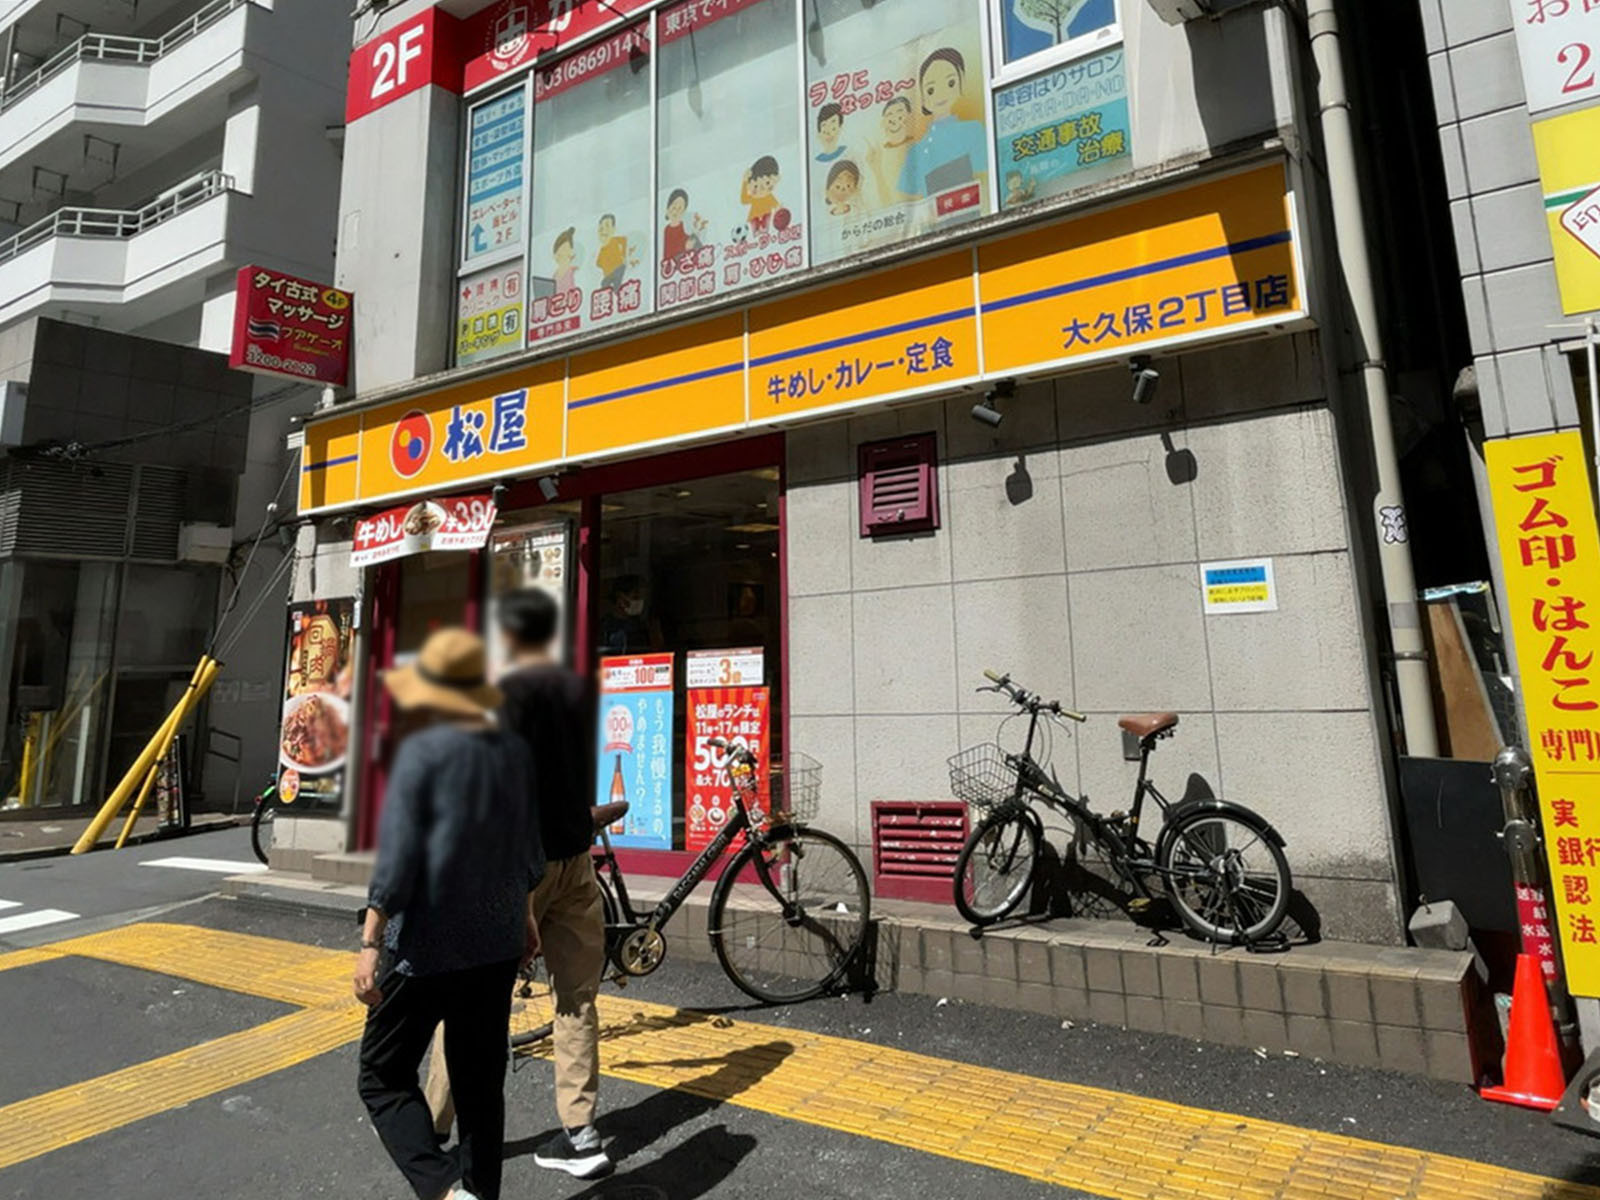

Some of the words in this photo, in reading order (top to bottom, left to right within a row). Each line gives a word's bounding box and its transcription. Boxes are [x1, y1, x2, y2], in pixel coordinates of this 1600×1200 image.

[1527, 0, 1600, 24] お
[370, 24, 424, 99] 2F
[808, 70, 869, 107] ラクに
[998, 52, 1124, 112] 美容はりサロン
[1012, 112, 1102, 162] 交通事故
[1077, 130, 1125, 166] 治療
[255, 272, 318, 303] タイ古式
[590, 279, 641, 320] 腰痛
[267, 297, 344, 329] マッサージ
[1062, 275, 1290, 349] 大久保2丁目店
[767, 336, 953, 403] 牛めし・カレー・定食
[441, 388, 528, 462] 松屋
[357, 513, 402, 547] 牛めし
[1512, 454, 1600, 712] ゴム印・はんこ
[1541, 728, 1600, 762] 専門
[1551, 799, 1579, 828] 実
[1557, 836, 1600, 868] 銀行
[1563, 874, 1592, 905] 認
[1569, 913, 1597, 944] 法
